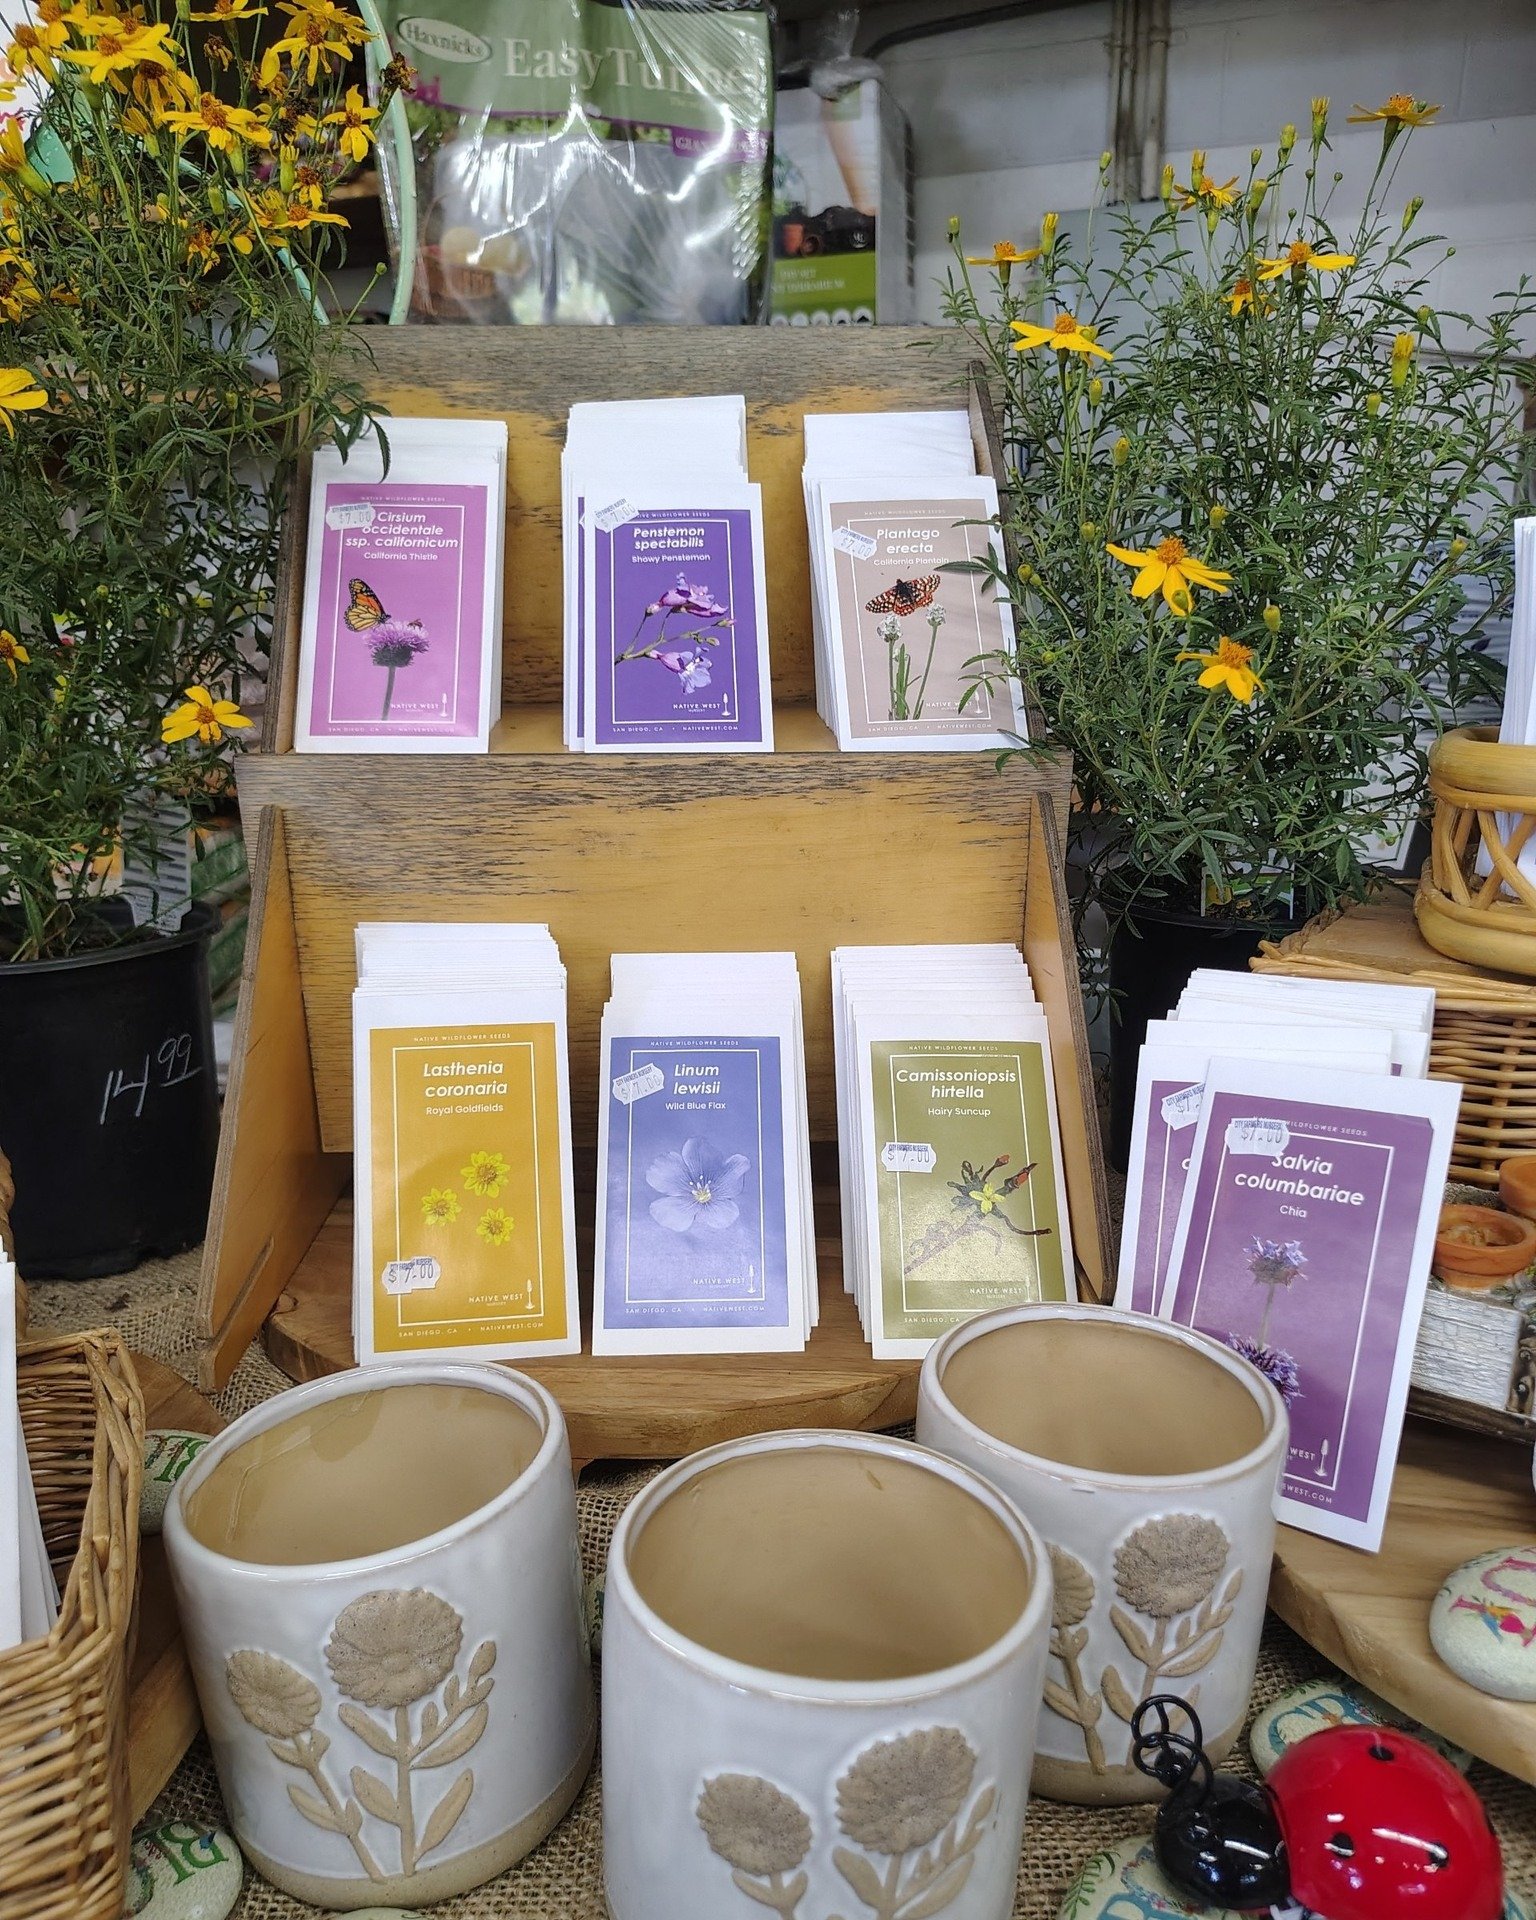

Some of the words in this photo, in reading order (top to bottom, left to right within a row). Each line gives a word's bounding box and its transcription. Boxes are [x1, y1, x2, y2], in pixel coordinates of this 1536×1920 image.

[377, 511, 426, 523] Cirsium
[362, 524, 444, 536] occidentale
[633, 527, 705, 538] Penstemon
[876, 528, 940, 541] Plantago
[345, 537, 370, 549] ssp.
[375, 536, 459, 548] californicum
[634, 537, 704, 551] spectabilis
[886, 543, 933, 554] erecta
[364, 551, 408, 561] California
[409, 552, 438, 561] Thistle
[631, 555, 660, 564] Showy
[661, 553, 711, 563] Penstemon
[873, 557, 914, 566] California
[915, 557, 949, 565] Plantain
[423, 1060, 504, 1077] Lasthenia
[674, 1064, 719, 1077] Linum
[896, 1068, 1016, 1085] Camissoniopsis
[424, 1080, 508, 1097] coronaria
[673, 1081, 720, 1095] lewisii
[931, 1085, 984, 1099] hirtella
[426, 1105, 453, 1117] Royal
[455, 1103, 504, 1114] Goldfields
[665, 1101, 685, 1110] Wild
[687, 1102, 706, 1110] Blue
[708, 1101, 726, 1110] Flax
[928, 1107, 952, 1118] Hairy
[954, 1107, 991, 1118] Suncup
[1340, 1127, 1368, 1137] SEEDS
[1271, 1153, 1333, 1176] Salvia
[1234, 1172, 1365, 1206] columbariae
[1280, 1205, 1307, 1218] Chia
[693, 1277, 721, 1285] NATIVE
[468, 1295, 499, 1303] NATIVE
[480, 1322, 544, 1332] NATIVEWEST.COM
[1290, 1446, 1315, 1461] WEST
[1282, 1483, 1332, 1504] EWEST.COM
